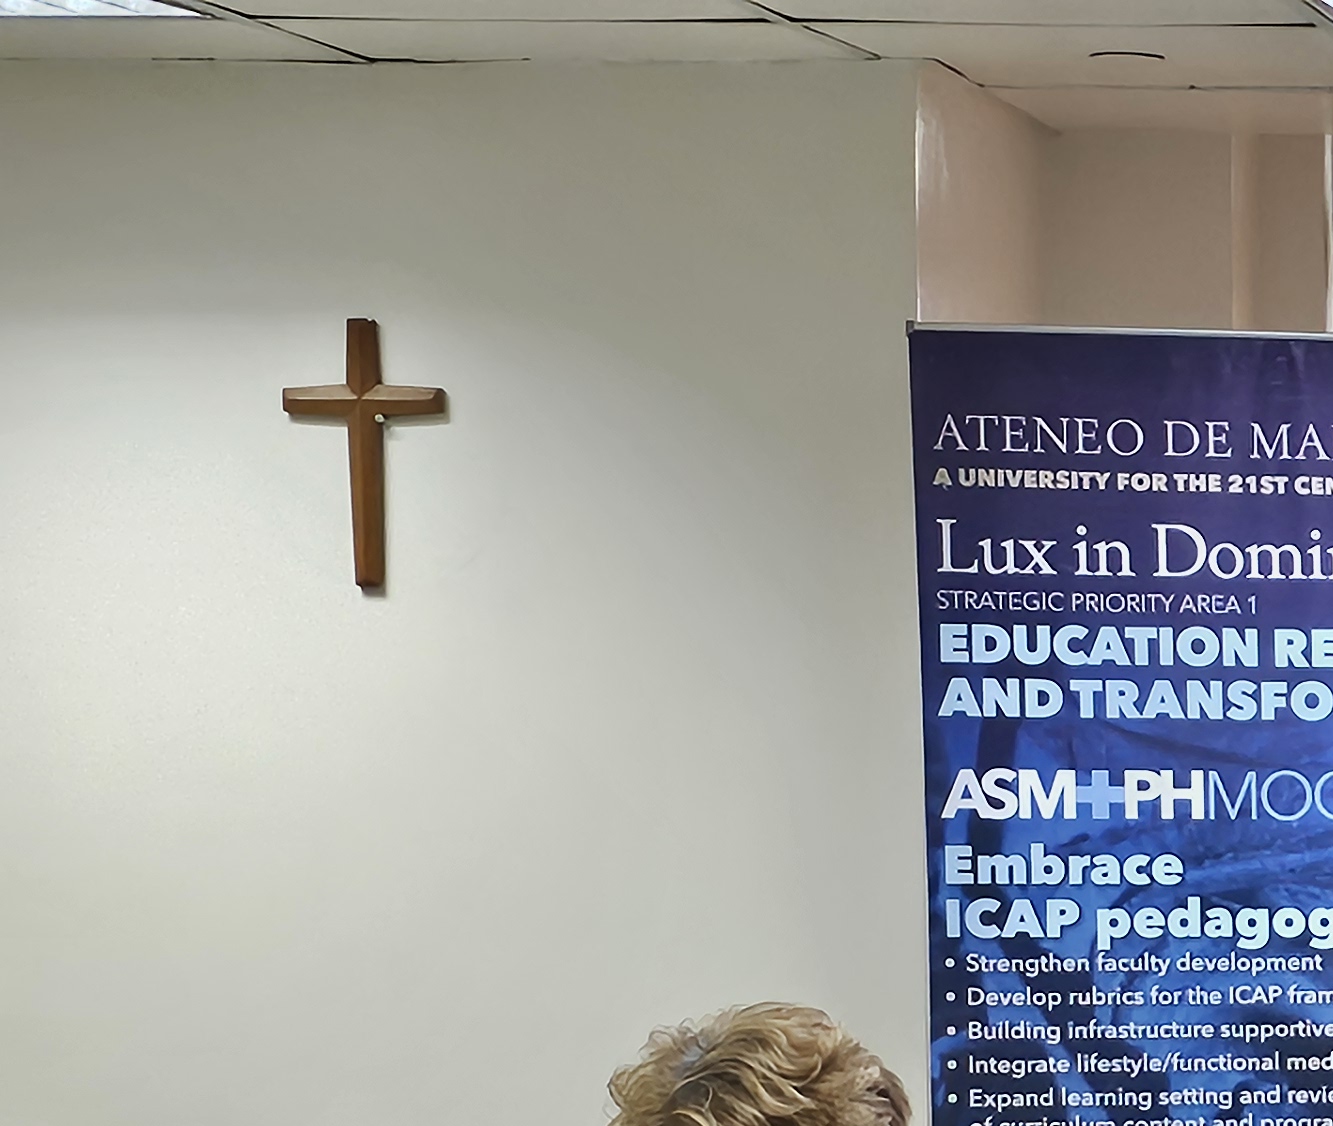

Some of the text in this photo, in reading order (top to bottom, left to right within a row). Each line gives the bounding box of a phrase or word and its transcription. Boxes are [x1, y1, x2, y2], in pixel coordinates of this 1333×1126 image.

[933, 415, 1144, 457] ATENEO
[1164, 420, 1231, 459] DE
[933, 469, 952, 488] A
[959, 469, 1110, 490] UNIVERSITY
[1117, 472, 1166, 492] FOR
[1174, 474, 1222, 493] THE
[1228, 475, 1288, 495] 21ST
[936, 519, 1058, 575] Lux
[1074, 526, 1136, 578] in
[937, 591, 1257, 614] STRATEGIC PRIORITY AREA 1
[939, 625, 1258, 667] EDUCATION
[938, 678, 1063, 718] AND
[944, 845, 1184, 887] Embrace
[946, 900, 1079, 939] ICAP
[966, 952, 1322, 976] Strengthen faculty development
[967, 987, 1061, 1010] Develop
[1068, 986, 1143, 1006] rubrics
[1150, 985, 1181, 1006] for
[1187, 986, 1222, 1005] the
[1229, 986, 1283, 1004] ICAP
[968, 1020, 1061, 1043] Building
[1068, 1019, 1214, 1040] infrastructure
[968, 1054, 1069, 1078] Integrate
[1076, 1050, 1279, 1075] lifestyle/functional
[969, 1087, 1054, 1111] Expand
[1061, 1086, 1153, 1111] learning
[1159, 1086, 1233, 1109] setting
[1239, 1085, 1281, 1105] and
